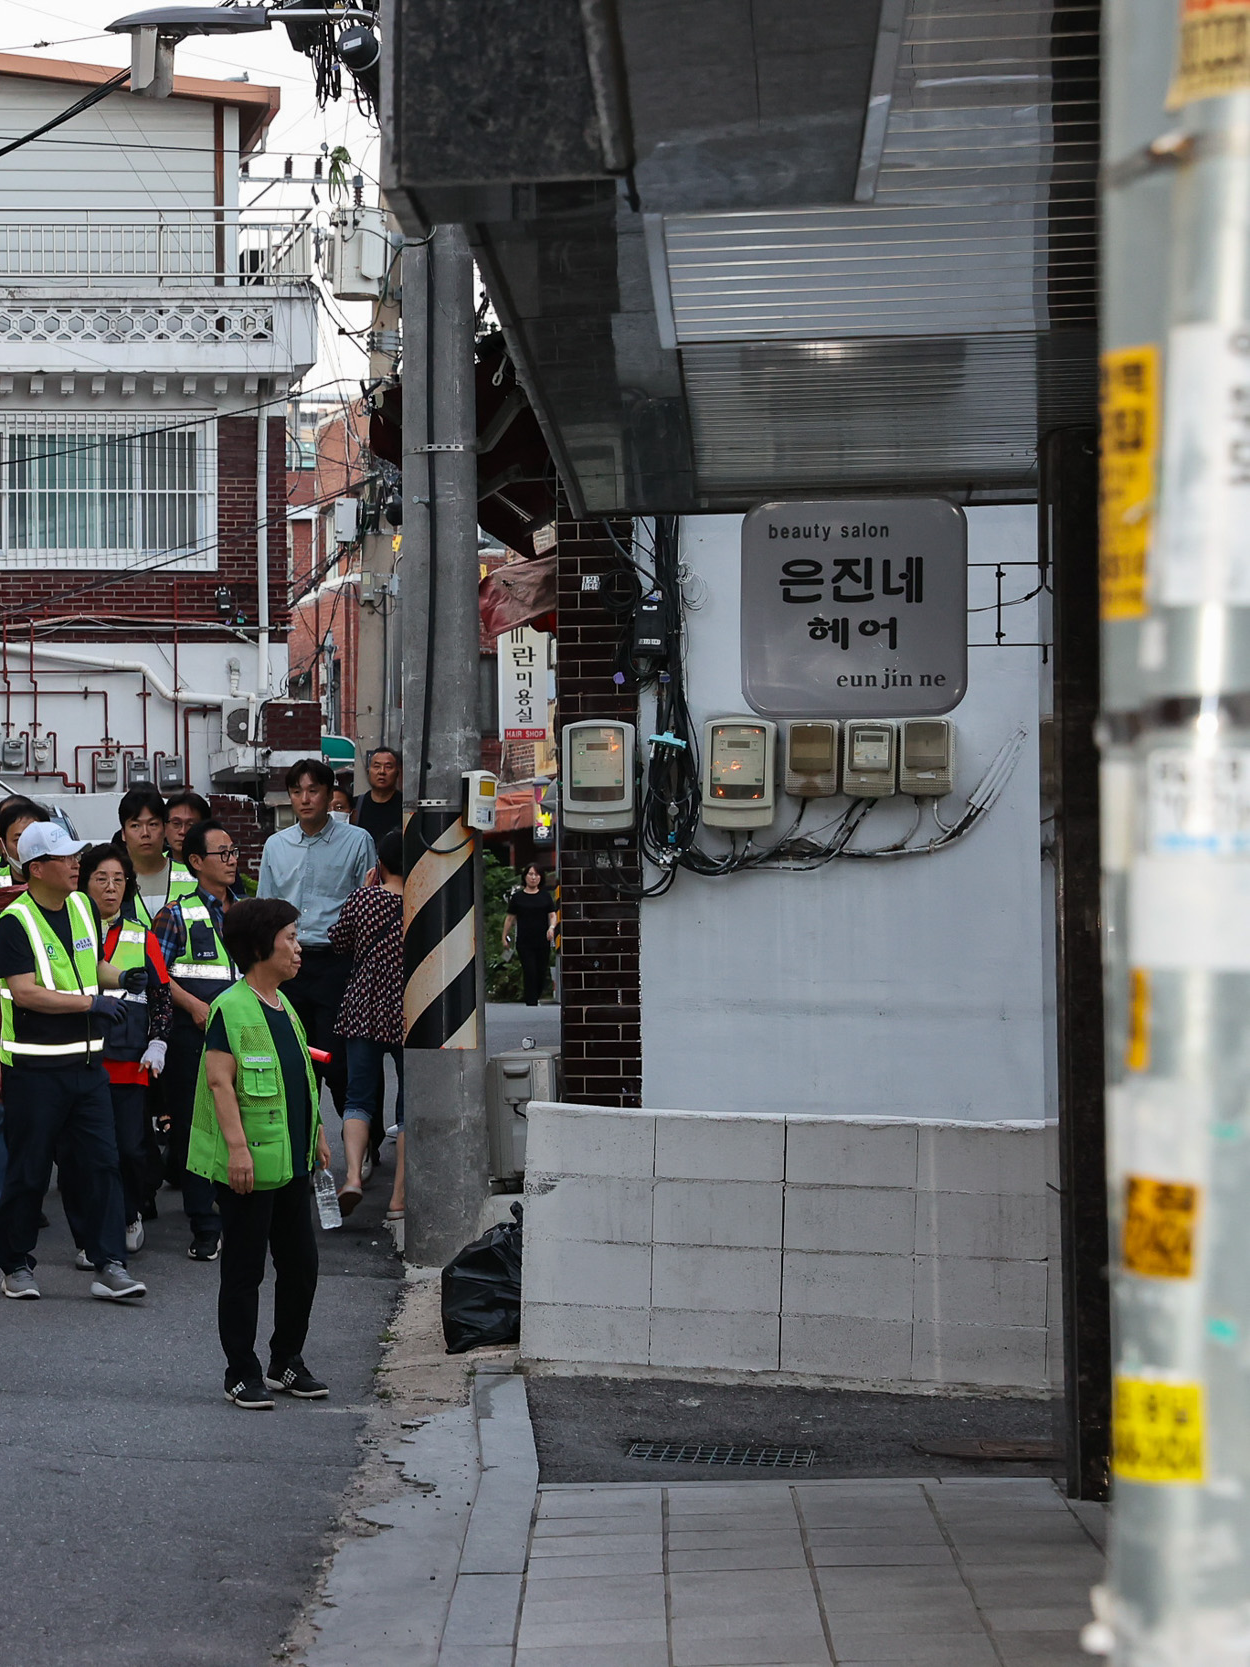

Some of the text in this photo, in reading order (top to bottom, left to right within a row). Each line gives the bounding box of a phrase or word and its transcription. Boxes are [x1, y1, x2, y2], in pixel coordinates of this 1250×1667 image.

[768, 522, 890, 542] beauty salon
[779, 556, 924, 604] 은진네
[807, 616, 897, 650] 헤어
[506, 730, 544, 739] HAIR SHOP
